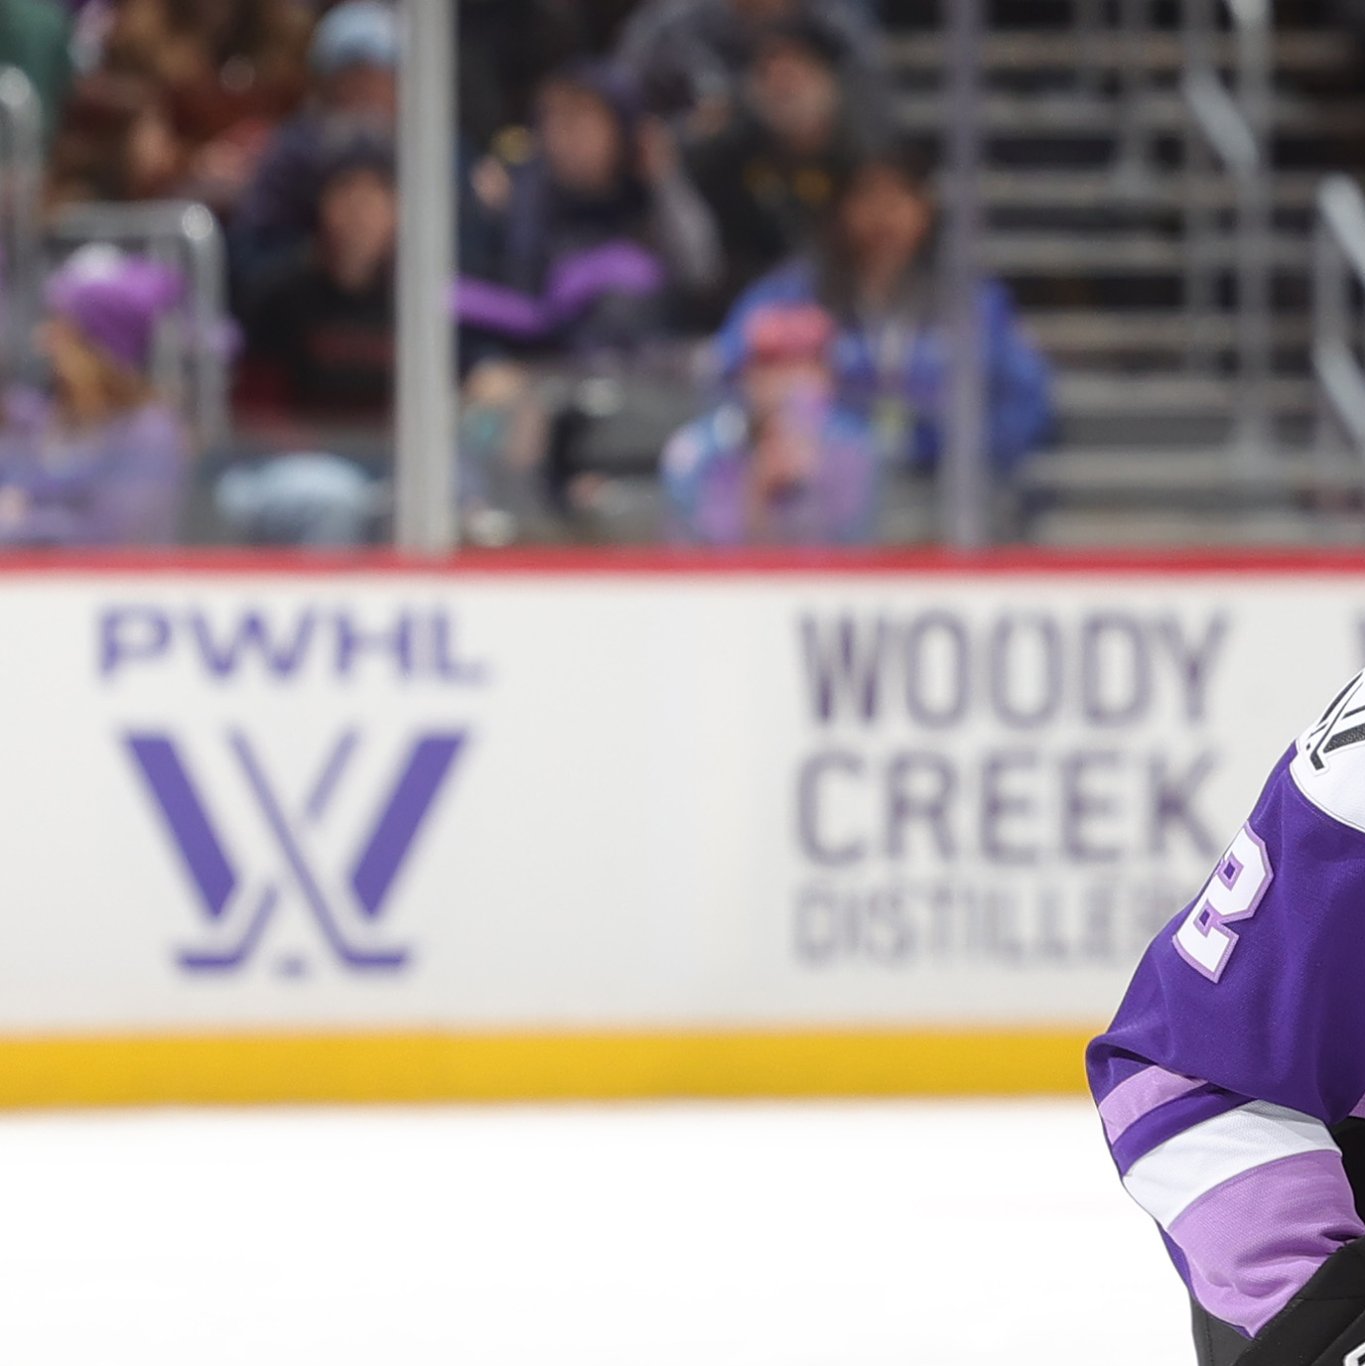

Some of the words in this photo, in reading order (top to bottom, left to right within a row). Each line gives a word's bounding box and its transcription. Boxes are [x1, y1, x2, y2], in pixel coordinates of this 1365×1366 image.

[98, 605, 490, 685] PWHL
[798, 608, 1230, 728] WOODY
[798, 748, 1228, 868] CREEK
[798, 885, 1178, 966] DISTILLE
